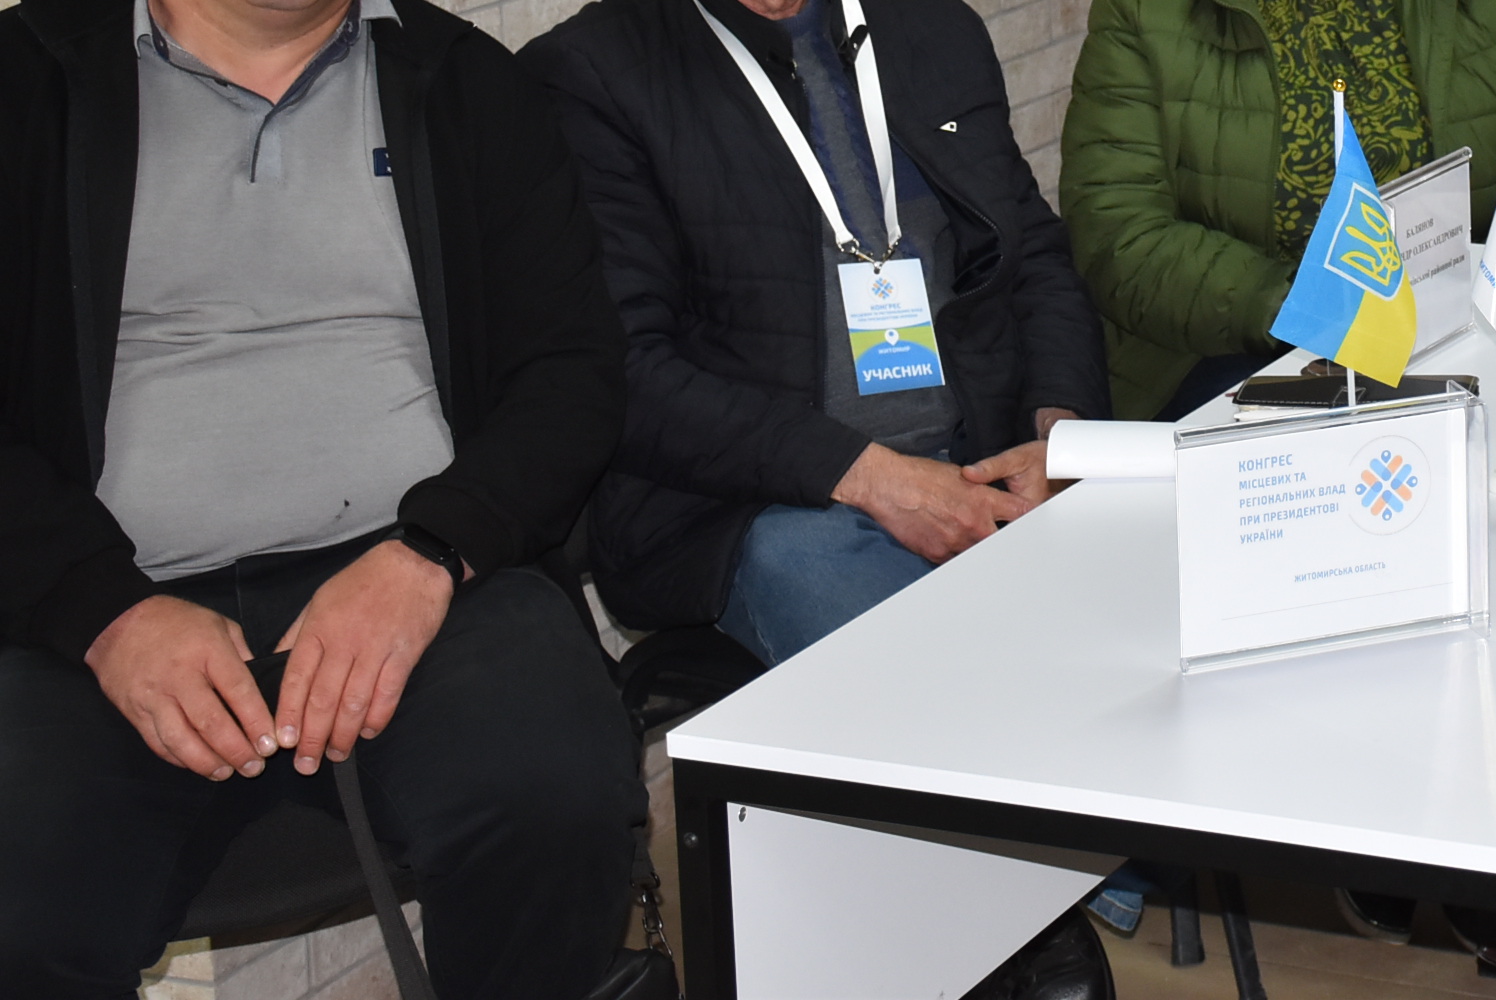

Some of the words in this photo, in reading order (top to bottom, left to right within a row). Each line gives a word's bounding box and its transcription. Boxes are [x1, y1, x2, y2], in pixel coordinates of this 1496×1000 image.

[862, 363, 933, 382] УЧАСНИК
[1238, 454, 1293, 473] КОНГРЕС
[1239, 474, 1291, 490] МІСЦЕВИХ
[1294, 472, 1306, 482] ТА
[1239, 488, 1316, 508] РЕГІОНАЛЬНИХ
[1318, 484, 1346, 497] ВЛАД
[1240, 514, 1261, 526] ПРИ
[1263, 502, 1339, 523] ПРЕЗИДЕНТОВІ
[1240, 528, 1284, 544] УКРАЇНИ
[1294, 566, 1353, 583] ЖИТОМИРСЬКА
[1354, 561, 1386, 574] ОБЛАСТЬ
